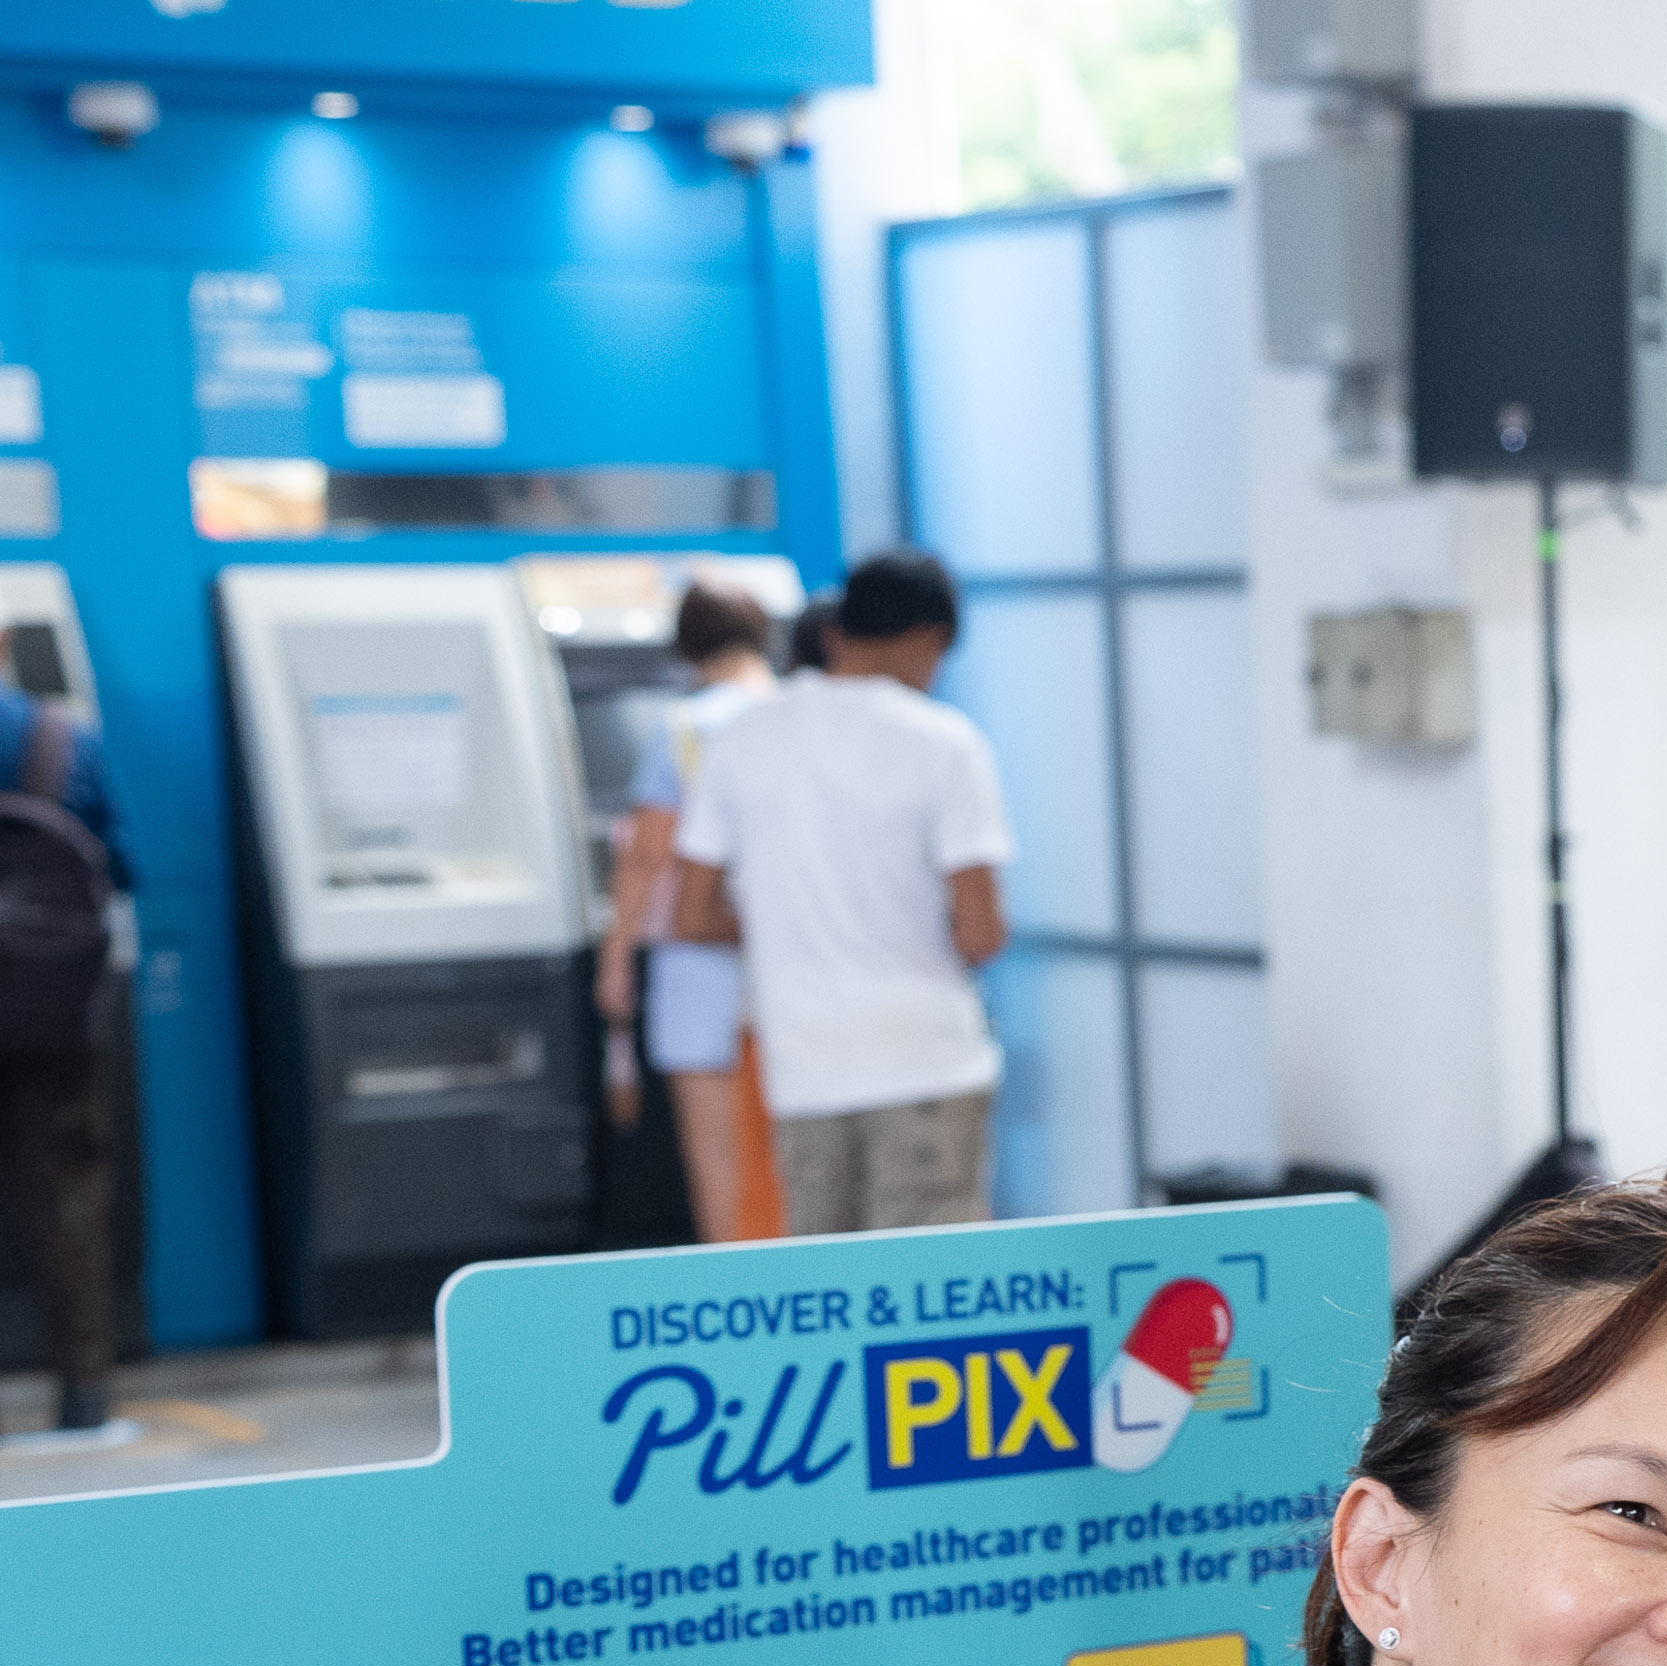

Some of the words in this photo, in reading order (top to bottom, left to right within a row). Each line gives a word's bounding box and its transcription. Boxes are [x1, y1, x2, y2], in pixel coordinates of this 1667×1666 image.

[611, 1289, 852, 1351] DISCOVER
[866, 1285, 899, 1327] &
[915, 1269, 1085, 1323] LEARN:
[602, 1359, 852, 1507] Pill
[883, 1343, 1079, 1470] PIX
[525, 1550, 740, 1612] Designed
[754, 1546, 820, 1585] for
[833, 1522, 1065, 1578] healthcare
[1077, 1482, 1339, 1557] professional
[628, 1592, 877, 1653] medication
[889, 1554, 1166, 1621] management
[1177, 1548, 1236, 1587] for
